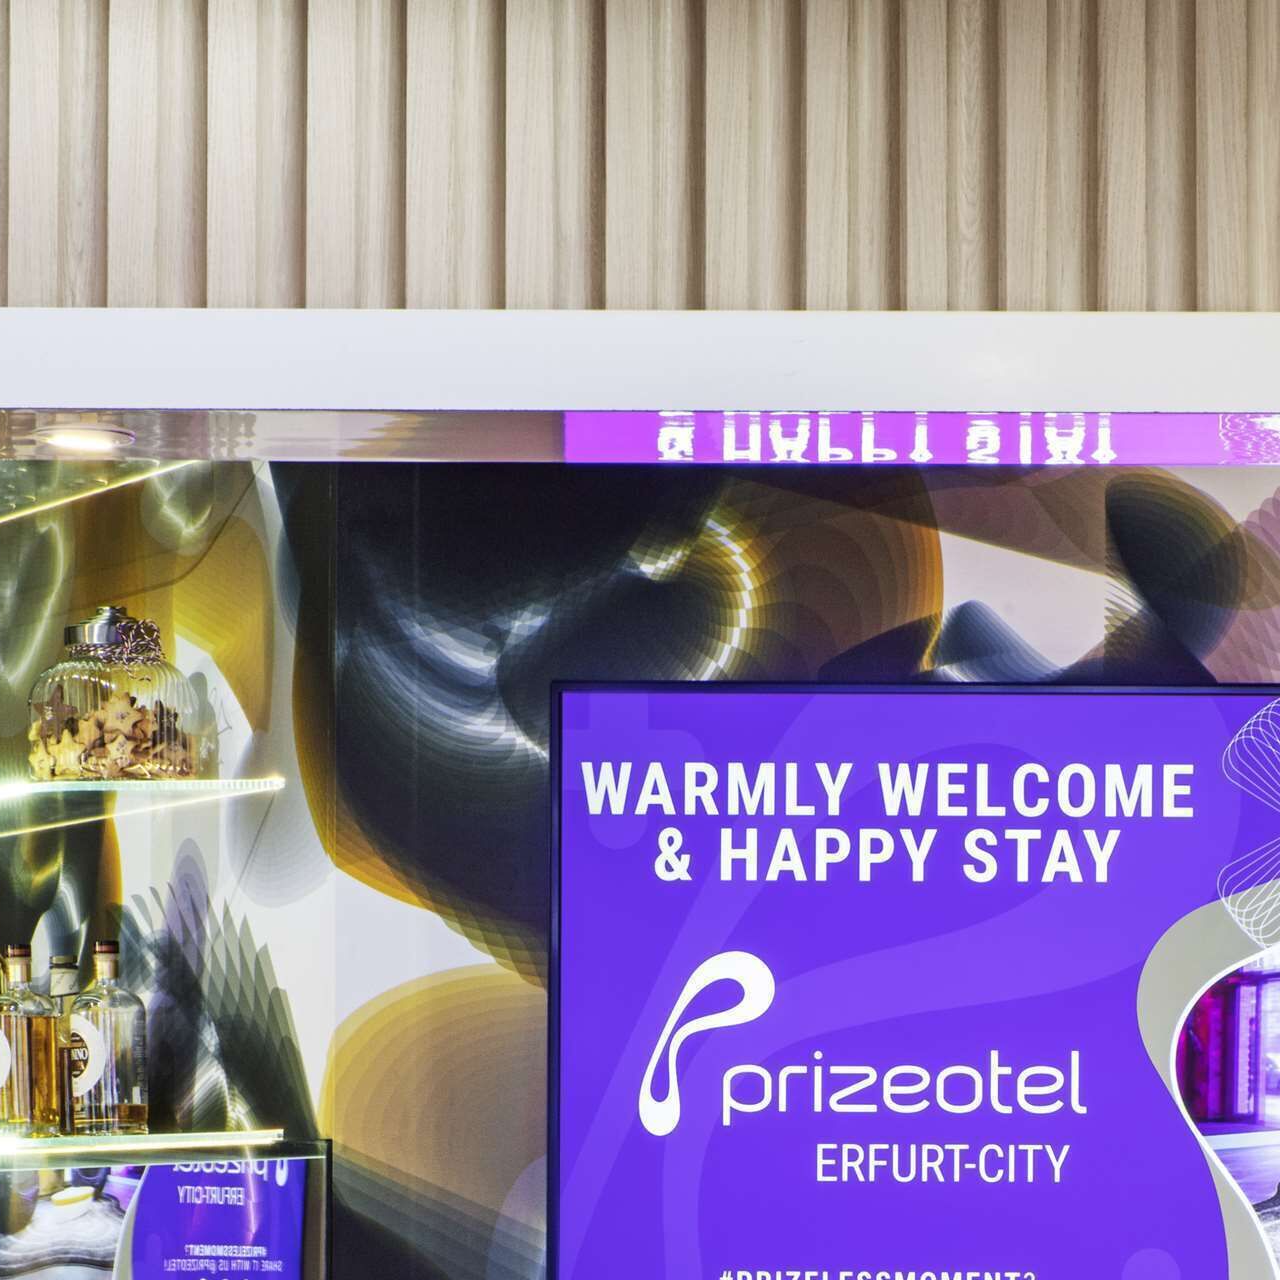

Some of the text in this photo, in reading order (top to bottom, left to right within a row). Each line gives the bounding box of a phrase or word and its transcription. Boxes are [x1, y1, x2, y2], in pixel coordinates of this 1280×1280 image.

[581, 761, 1194, 818] WARMLY WELCOME
[654, 827, 1121, 883] & HAPPY STAY
[722, 1049, 1088, 1126] prizeotel
[816, 1143, 1070, 1183] ERFURT-CITY
